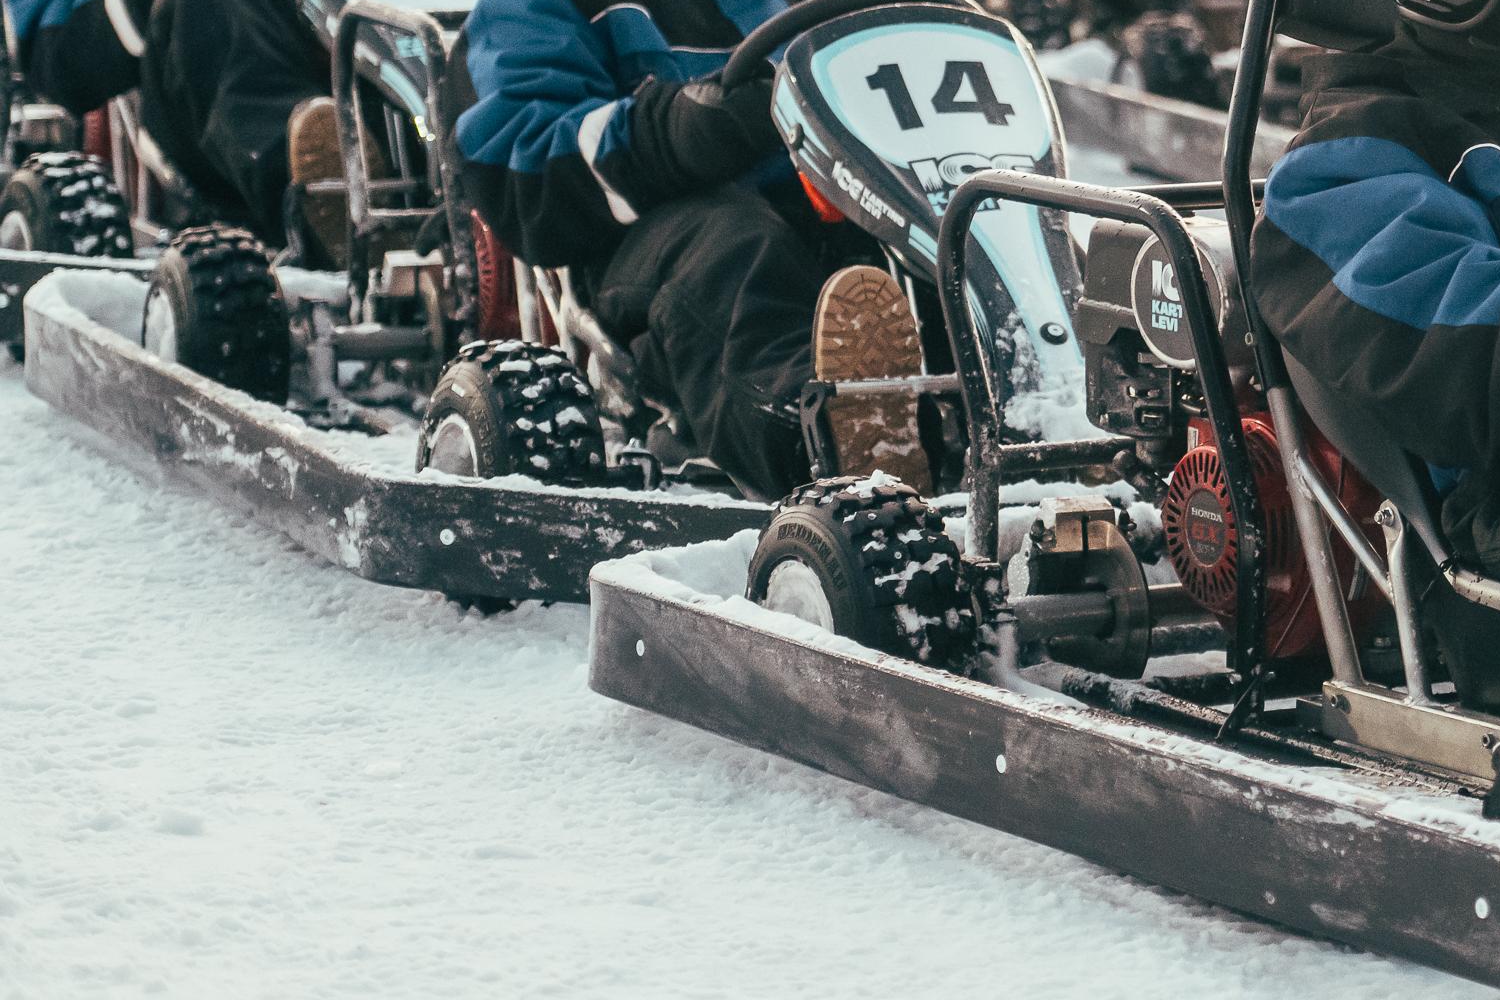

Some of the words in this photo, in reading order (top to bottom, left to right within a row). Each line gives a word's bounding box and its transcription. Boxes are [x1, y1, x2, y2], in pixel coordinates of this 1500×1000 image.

[865, 61, 1016, 131] 14
[832, 161, 864, 200] ICE
[1152, 260, 1180, 302] IC
[1152, 314, 1178, 332] LEVI
[1191, 506, 1222, 523] HONDA
